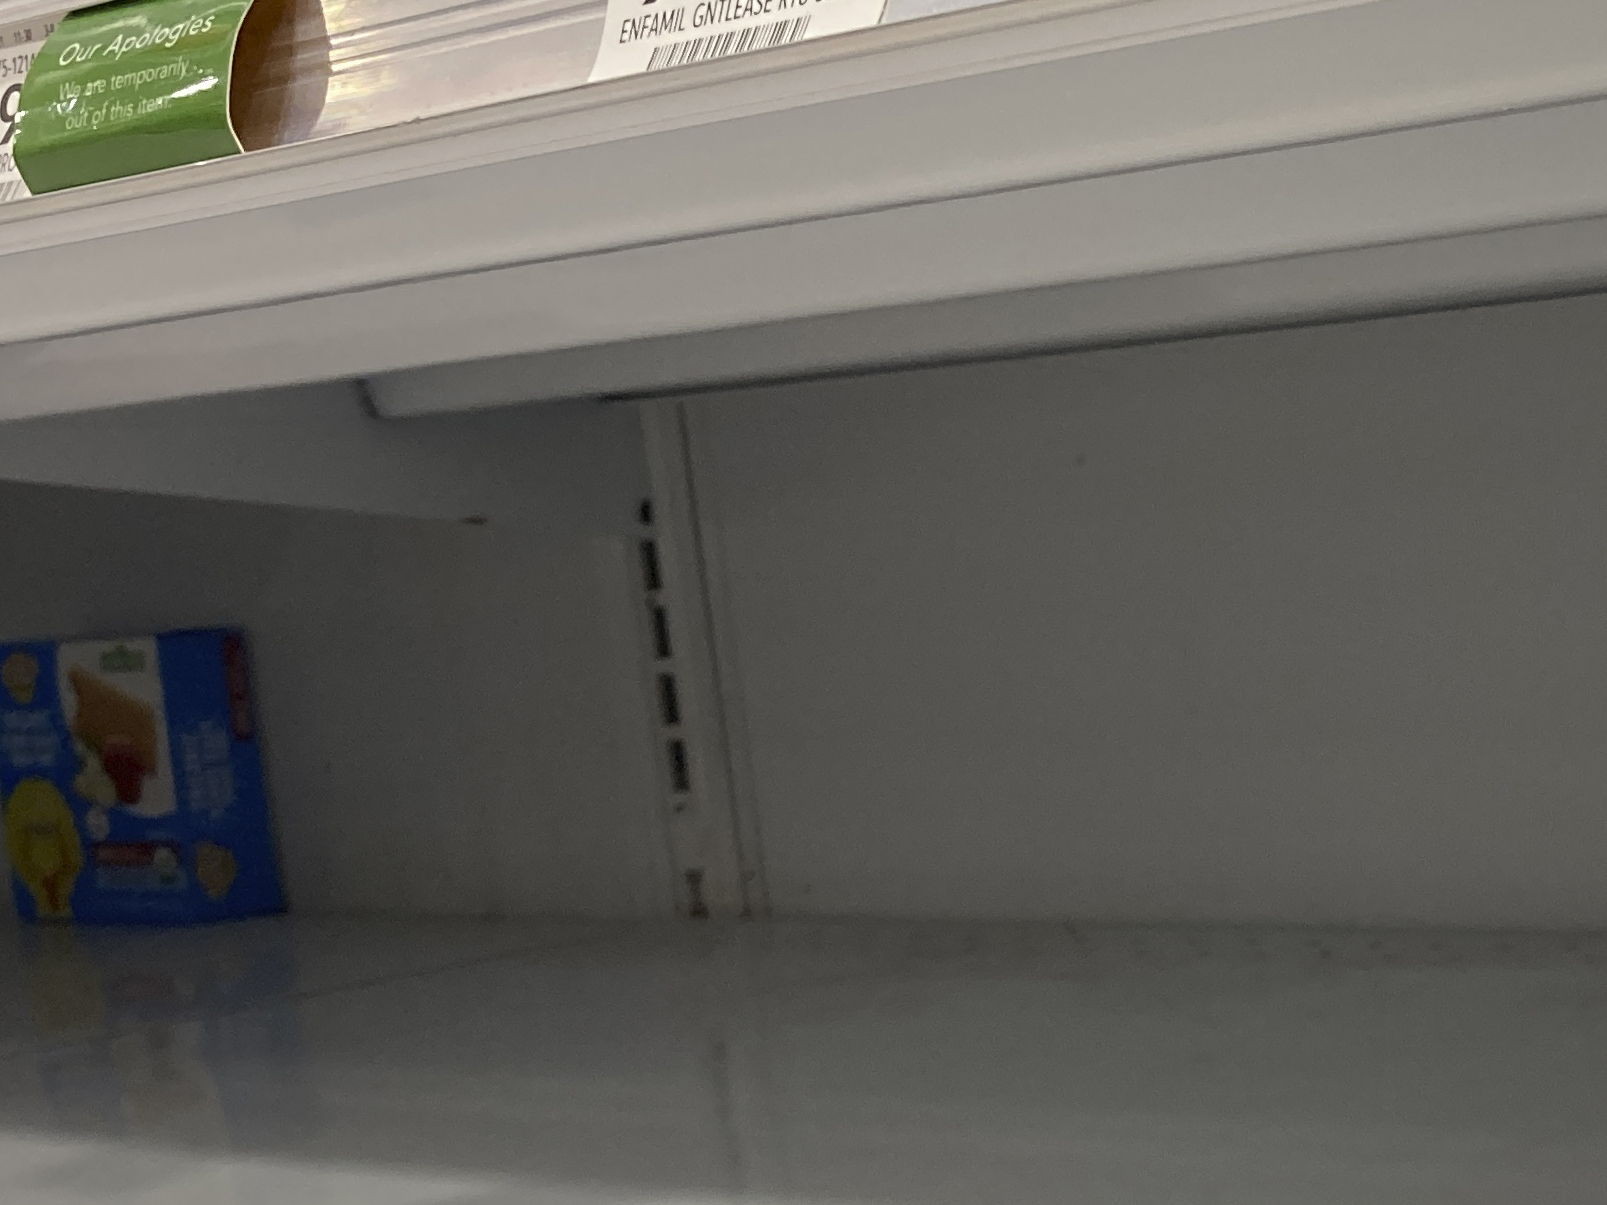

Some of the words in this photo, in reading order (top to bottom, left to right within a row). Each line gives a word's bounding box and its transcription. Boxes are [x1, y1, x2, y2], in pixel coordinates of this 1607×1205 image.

[59, 42, 102, 66] Our
[103, 14, 215, 61] Apologies
[619, 7, 685, 44] ENFAMIL
[60, 82, 81, 101] We
[84, 79, 105, 97] are
[65, 107, 88, 130] out
[92, 104, 107, 127] of
[110, 100, 134, 120] this
